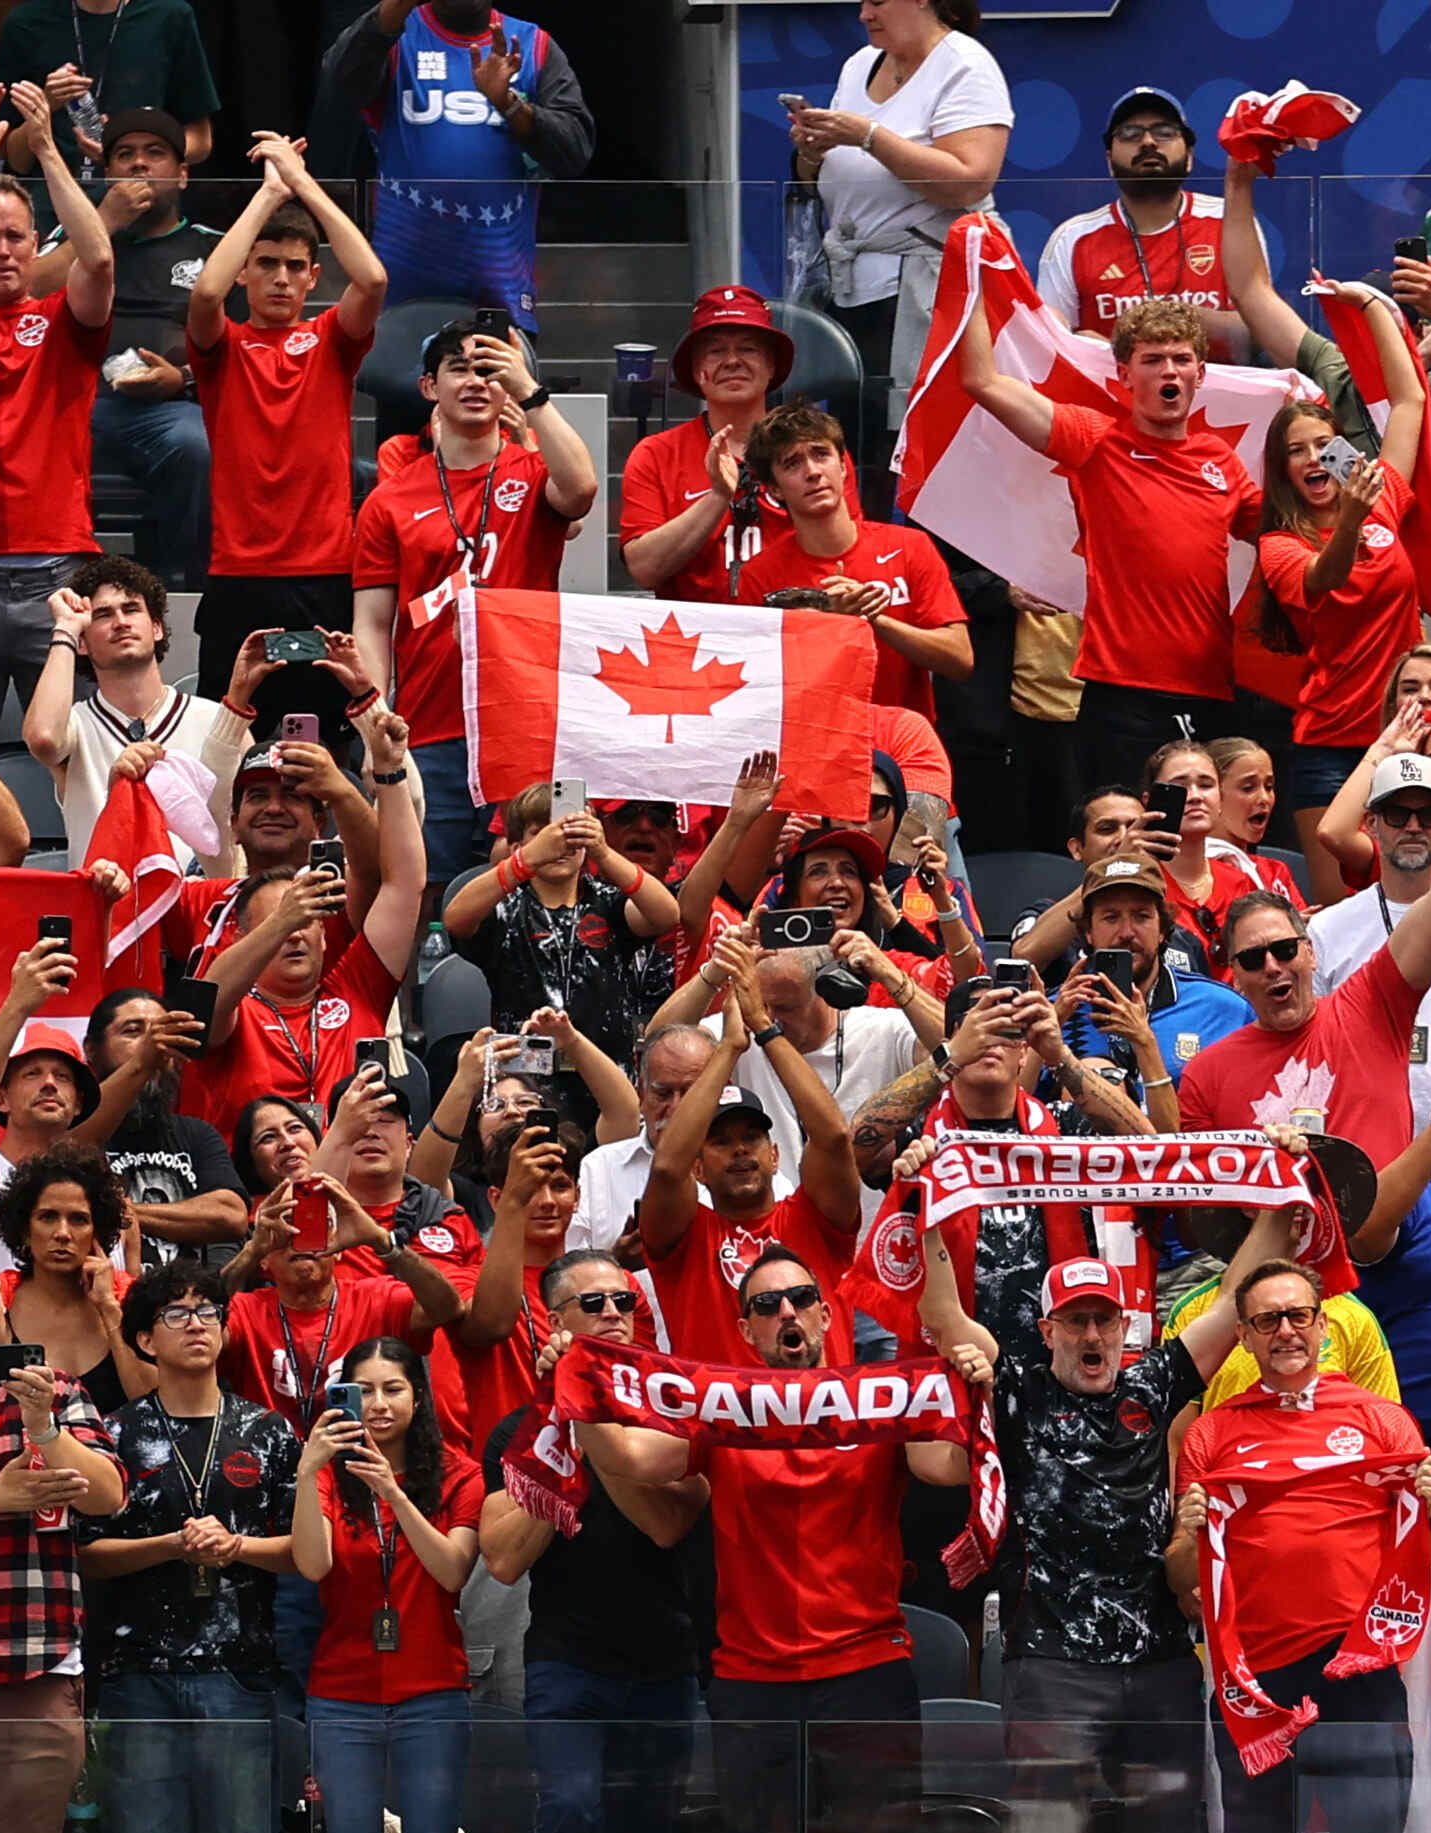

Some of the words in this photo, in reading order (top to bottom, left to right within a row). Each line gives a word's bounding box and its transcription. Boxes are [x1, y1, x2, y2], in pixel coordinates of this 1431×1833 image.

[1096, 290, 1219, 319] Emrates
[1400, 759, 1423, 782] LA
[932, 1144, 1282, 1192] VOYAGEURS
[1006, 1187, 1088, 1199] ROUGES
[1101, 1187, 1139, 1199] LES
[1151, 1187, 1213, 1198] ALLEZ
[645, 1372, 957, 1427] CANADA
[1369, 1606, 1422, 1626] CANADA
